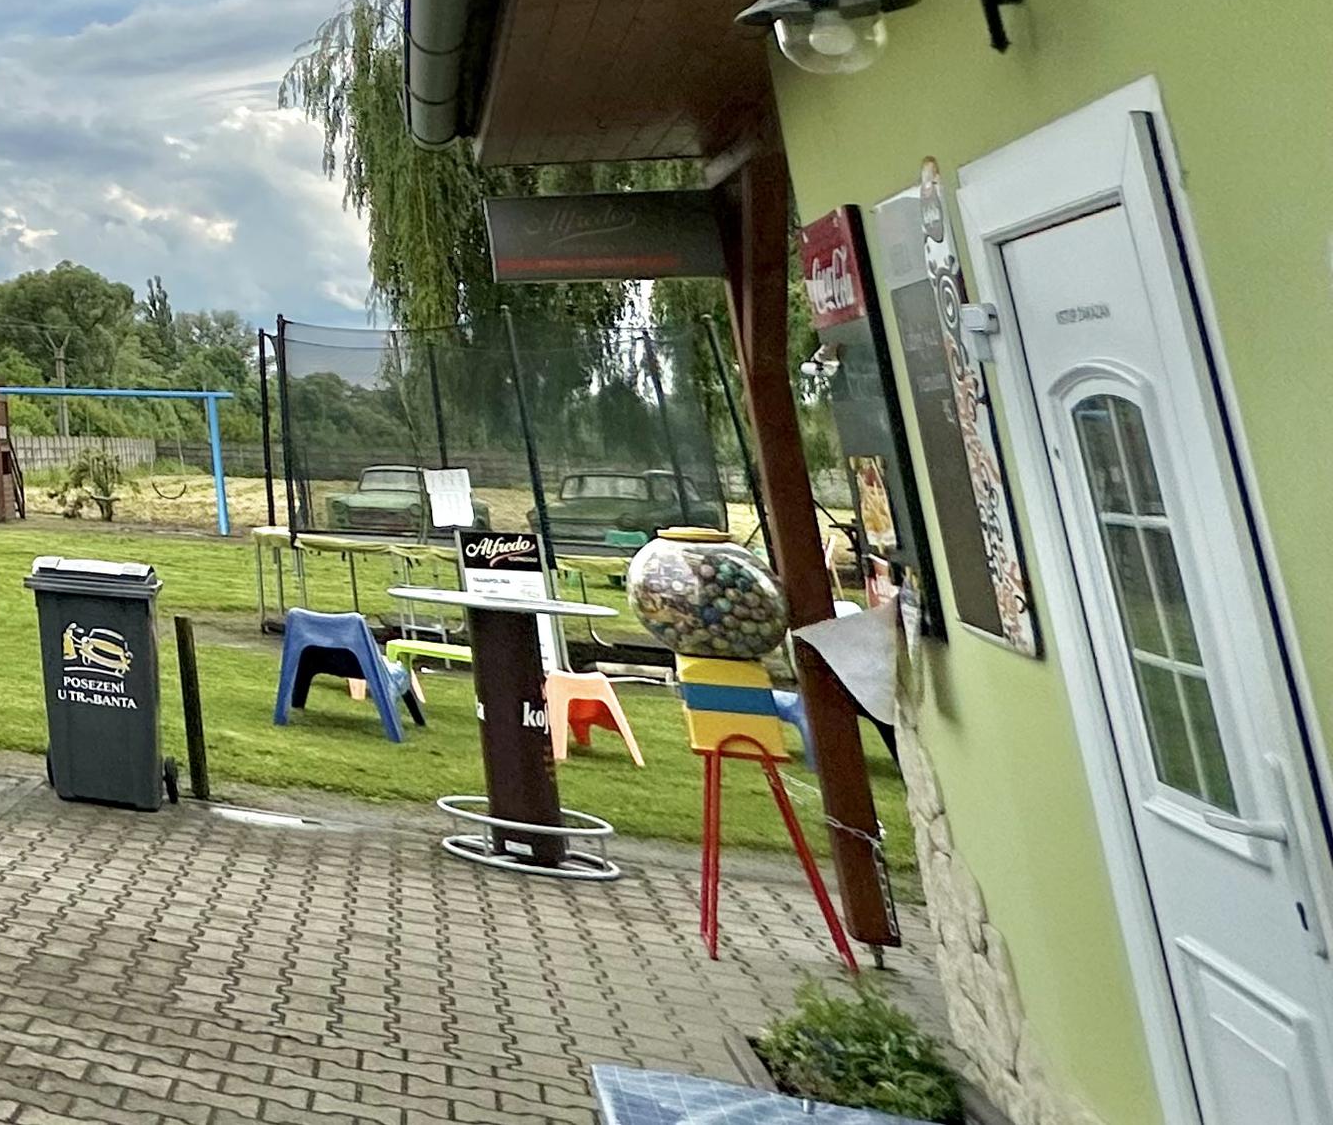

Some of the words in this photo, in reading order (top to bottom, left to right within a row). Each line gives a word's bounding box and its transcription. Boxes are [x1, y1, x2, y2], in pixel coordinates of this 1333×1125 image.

[466, 535, 531, 559] Alfredo
[63, 676, 124, 693] POSEZENÍ
[57, 689, 67, 700] U
